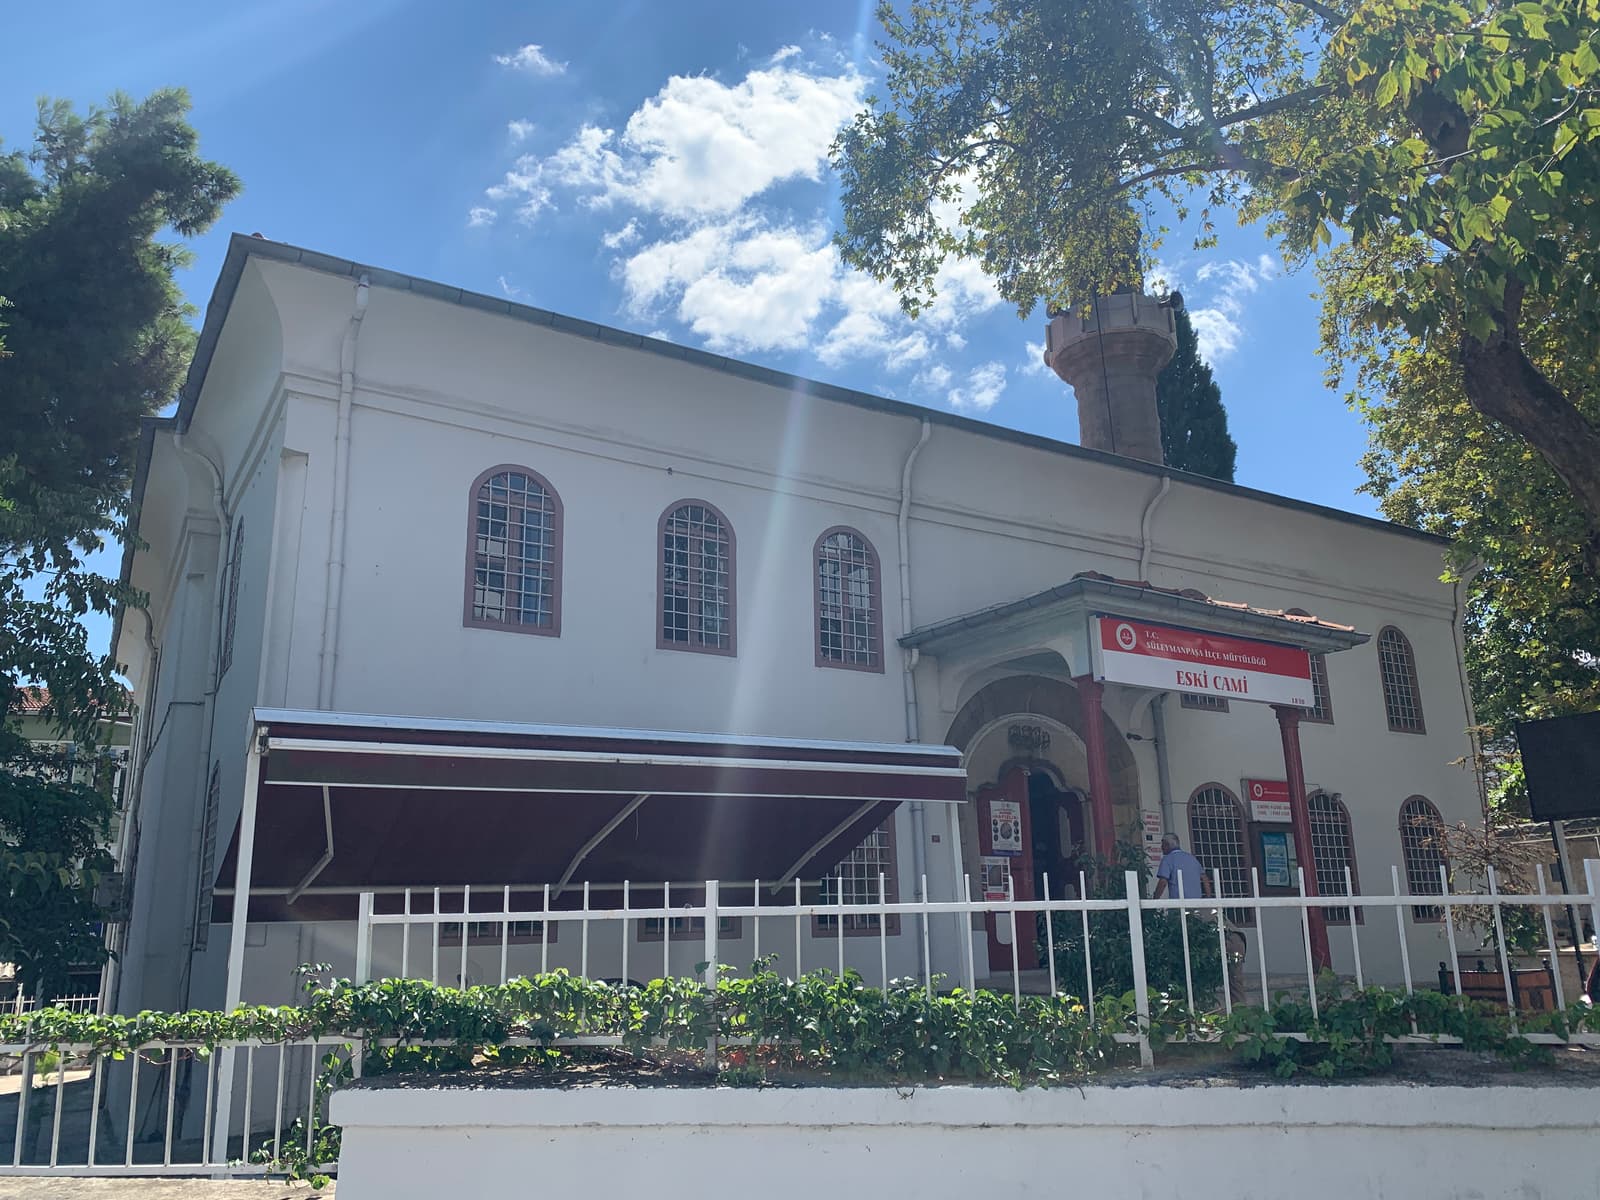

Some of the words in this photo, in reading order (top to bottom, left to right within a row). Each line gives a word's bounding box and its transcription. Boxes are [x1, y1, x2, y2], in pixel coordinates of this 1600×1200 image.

[1145, 630, 1159, 640] T.C.
[1146, 641, 1203, 657] SÜLEYMANPAŞA
[1204, 649, 1220, 660] İLÇE
[1222, 652, 1267, 666] MÜFTÜLÜĞÜ
[1176, 669, 1209, 689] ESKİ
[1213, 674, 1249, 694] CAMİ
